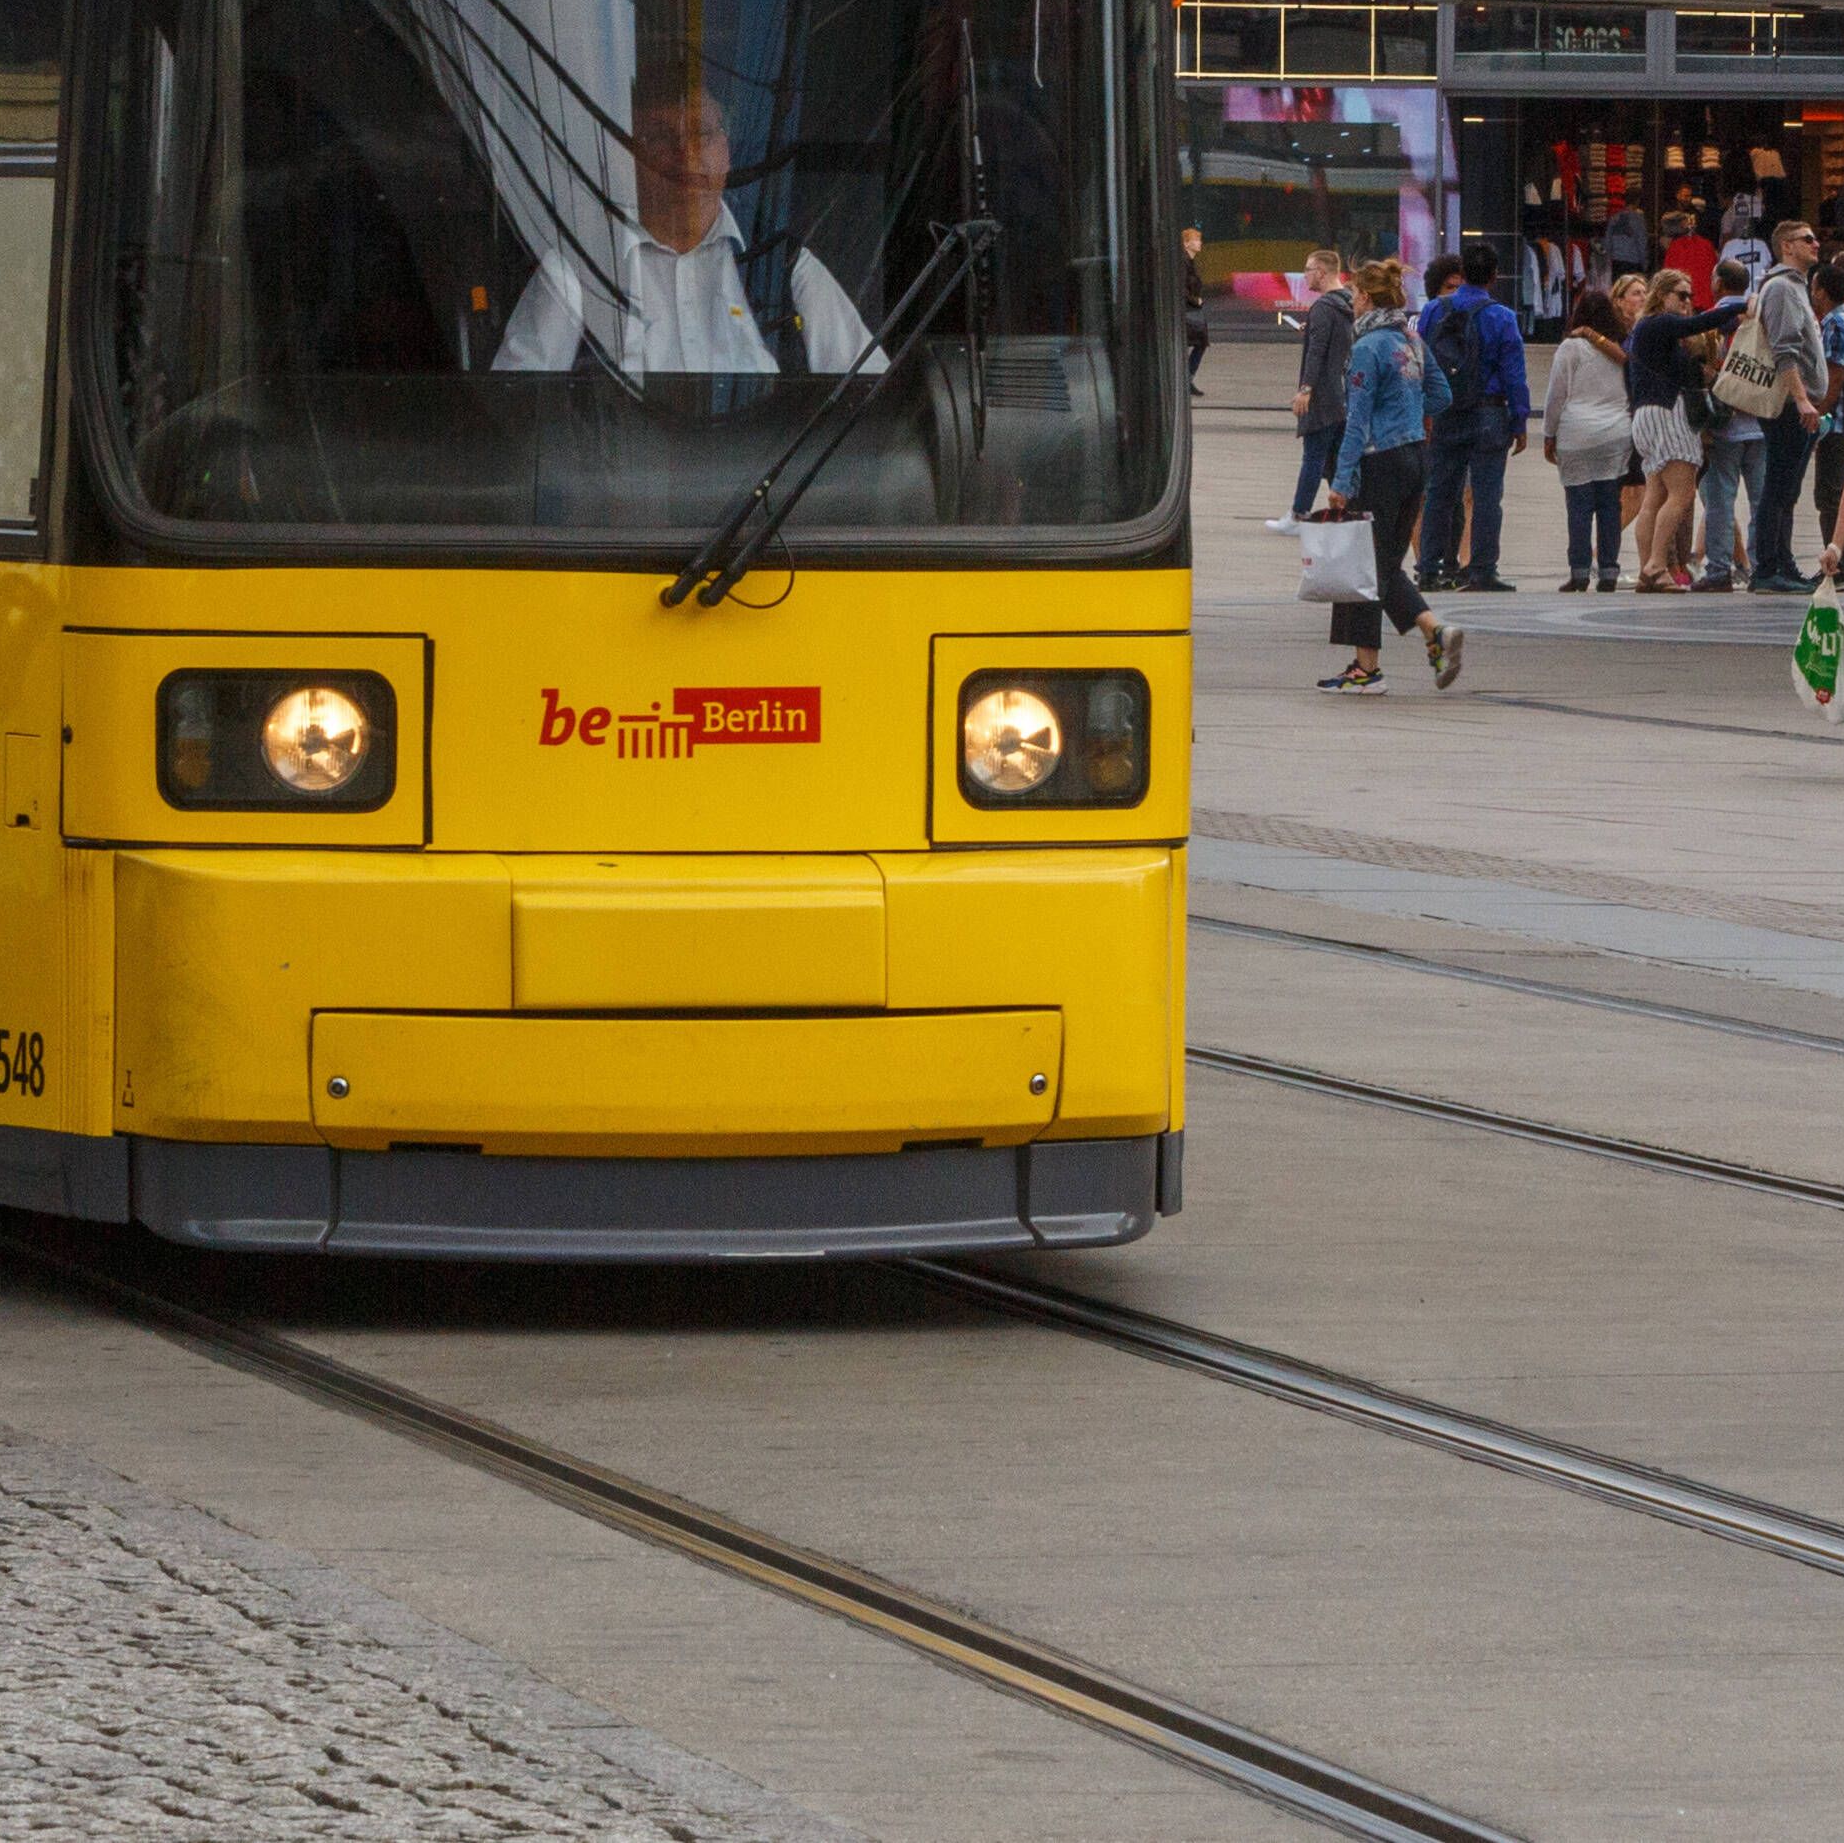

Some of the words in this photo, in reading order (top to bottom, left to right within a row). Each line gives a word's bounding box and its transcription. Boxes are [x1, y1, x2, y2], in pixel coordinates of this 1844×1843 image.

[1723, 358, 1776, 389] BERLIN
[539, 688, 612, 746] be
[702, 700, 806, 733] Berlin
